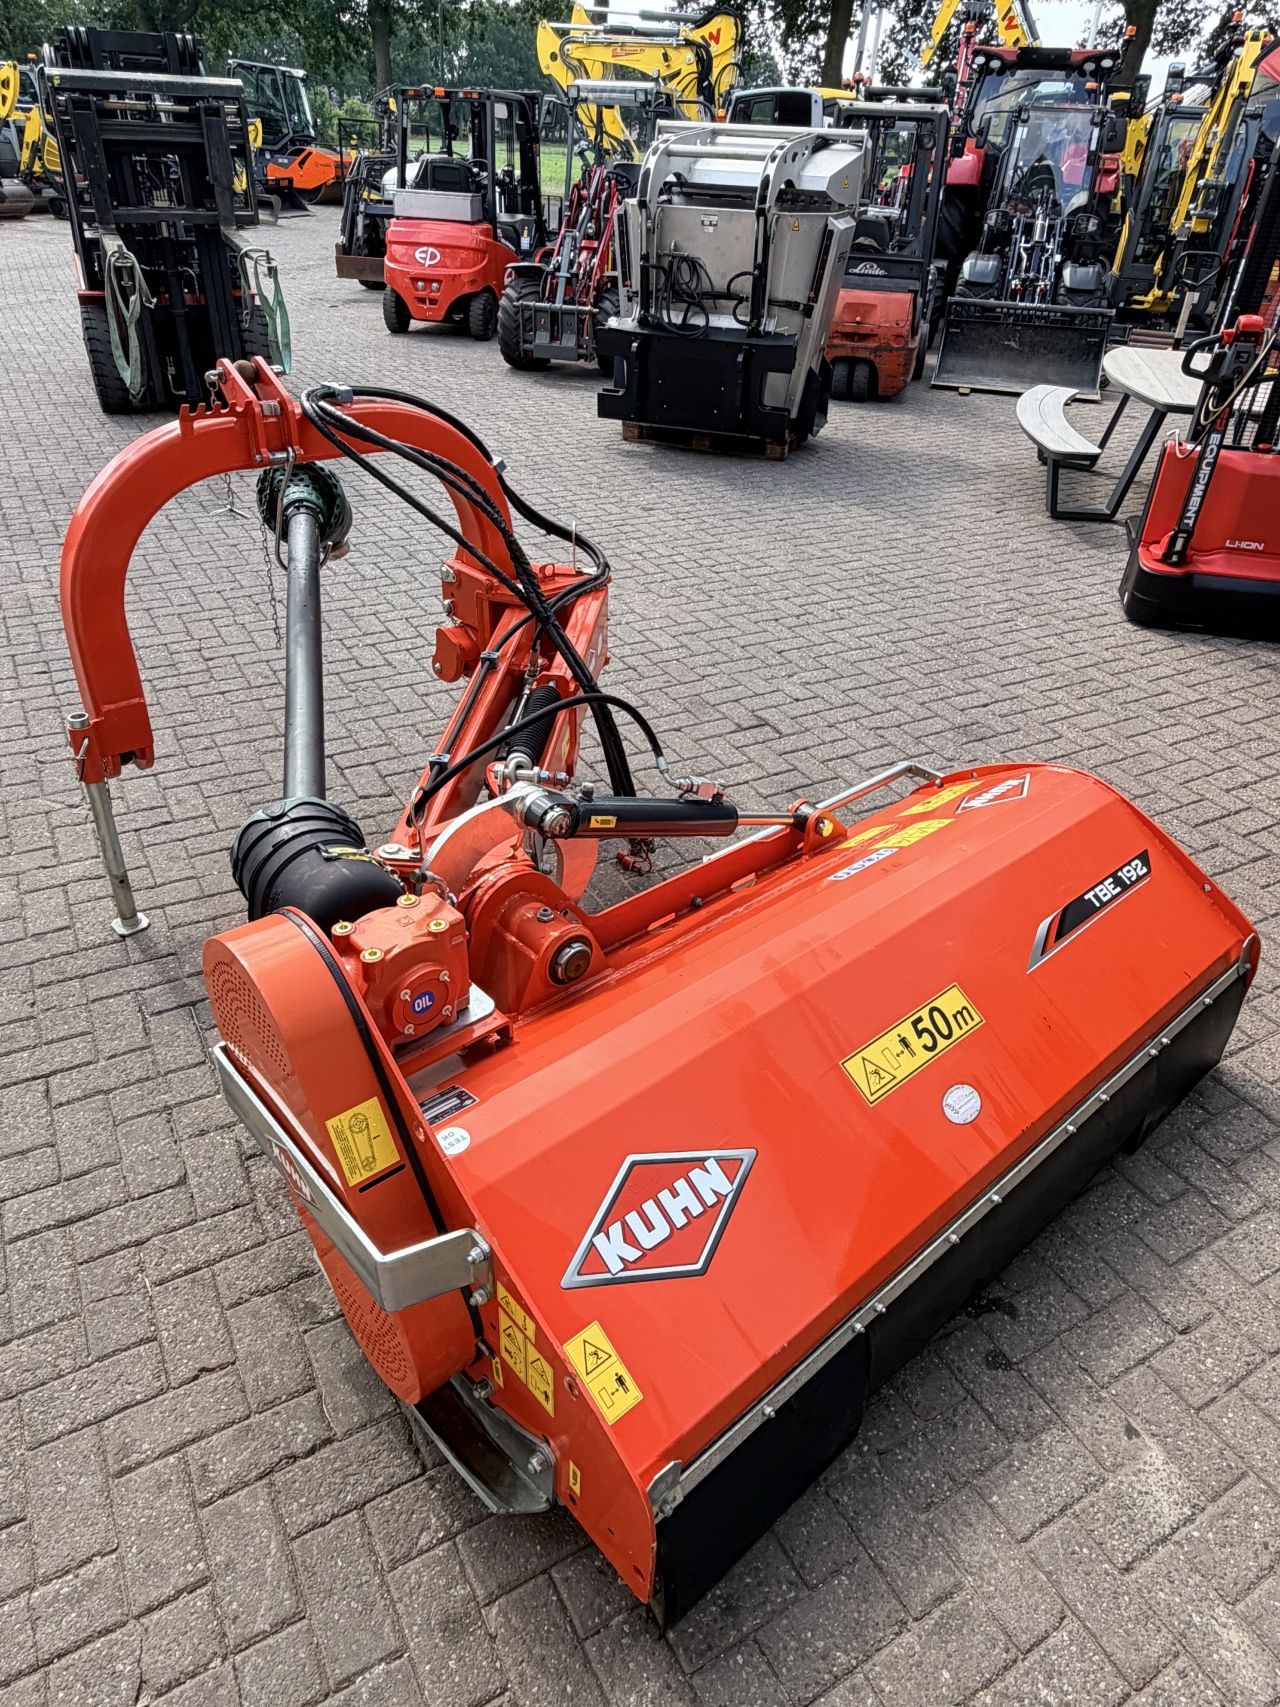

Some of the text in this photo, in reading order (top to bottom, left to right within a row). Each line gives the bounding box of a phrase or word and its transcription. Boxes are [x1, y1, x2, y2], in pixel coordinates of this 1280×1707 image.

[415, 246, 441, 268] EP
[848, 261, 888, 276] Linde
[1183, 433, 1221, 527] EQUIPMENT
[1084, 859, 1148, 908] TBE 192
[414, 994, 433, 1013] OIL
[271, 1140, 312, 1201] KUHN
[591, 1156, 735, 1276] KUHN
